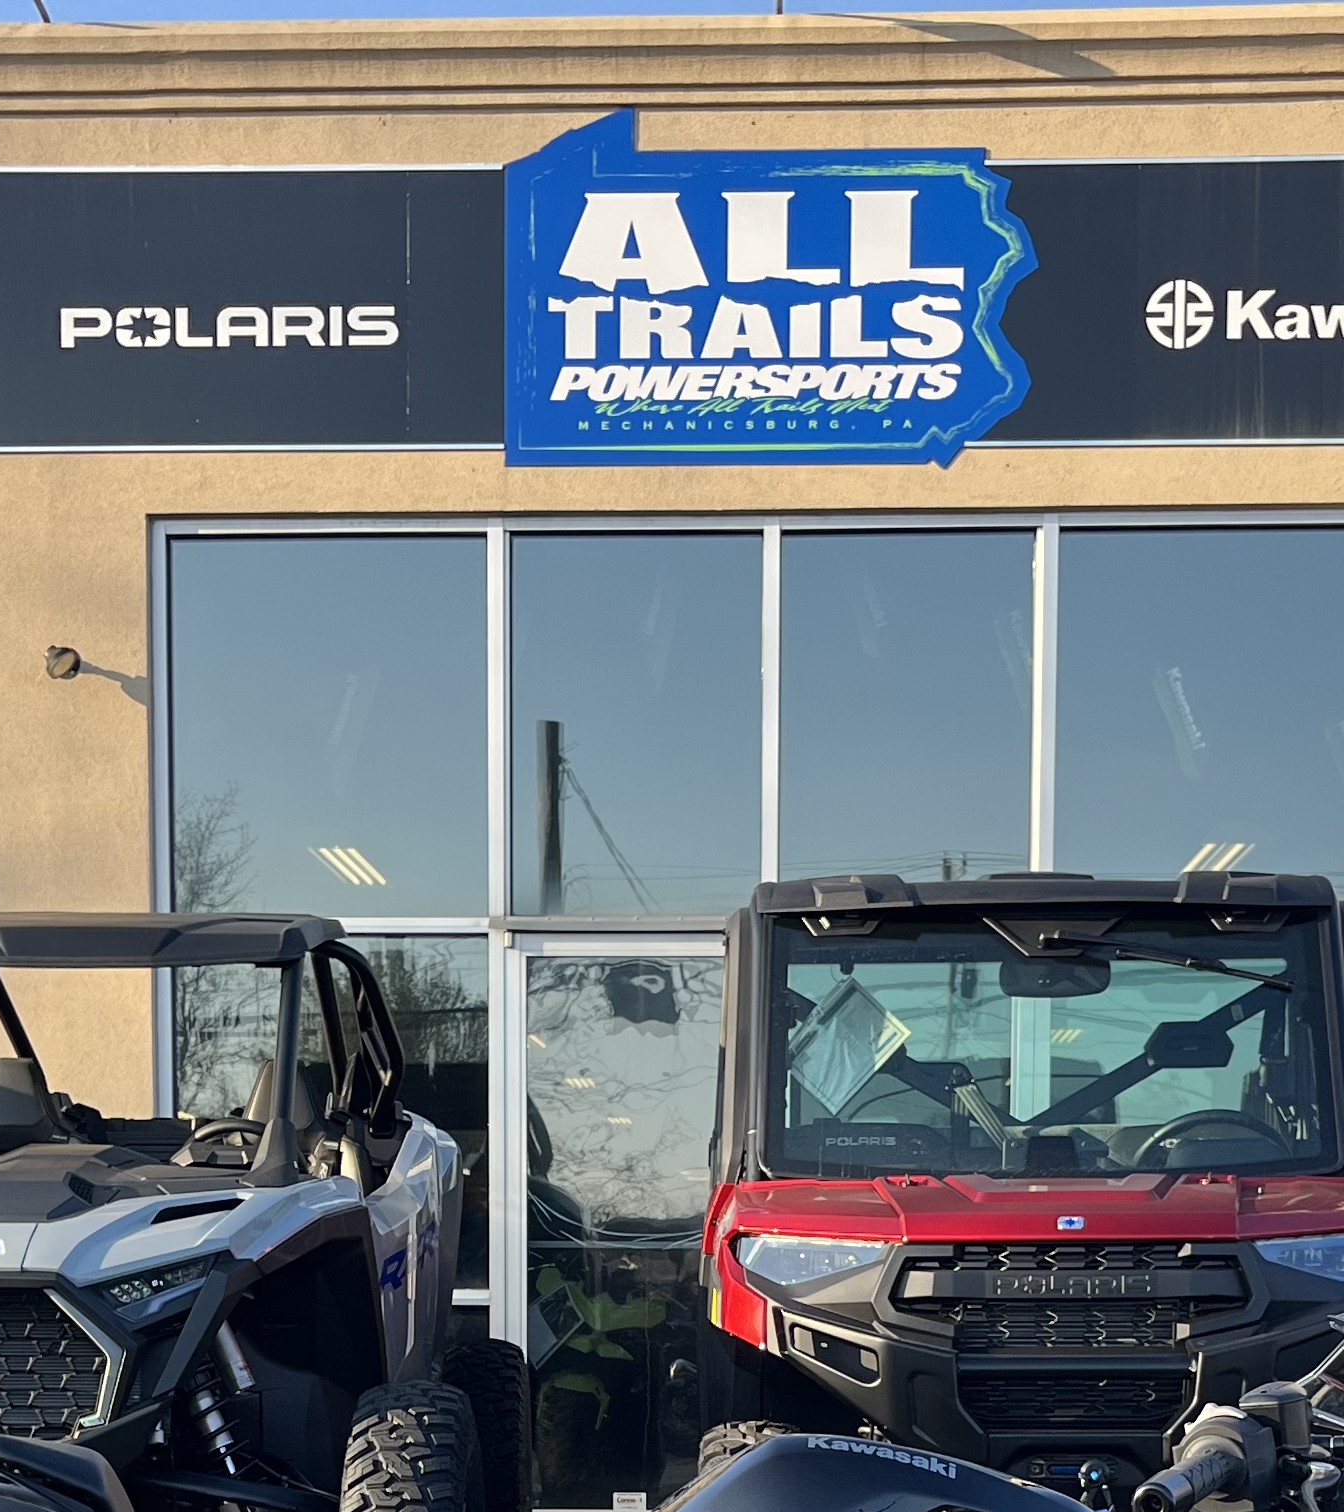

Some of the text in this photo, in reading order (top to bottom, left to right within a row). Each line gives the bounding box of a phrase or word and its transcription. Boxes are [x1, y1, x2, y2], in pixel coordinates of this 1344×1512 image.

[559, 190, 965, 294] ALL
[59, 305, 399, 348] POLARIS
[548, 294, 964, 360] TRAILS
[549, 363, 962, 402] POWERSPORTS
[595, 397, 683, 417] Where
[687, 397, 740, 417] All
[751, 396, 822, 416] Trails
[882, 419, 912, 430] PA
[824, 1136, 897, 1147] POLARIS
[993, 1274, 1153, 1296] POLARIS
[807, 1435, 958, 1481] Kawasaki
